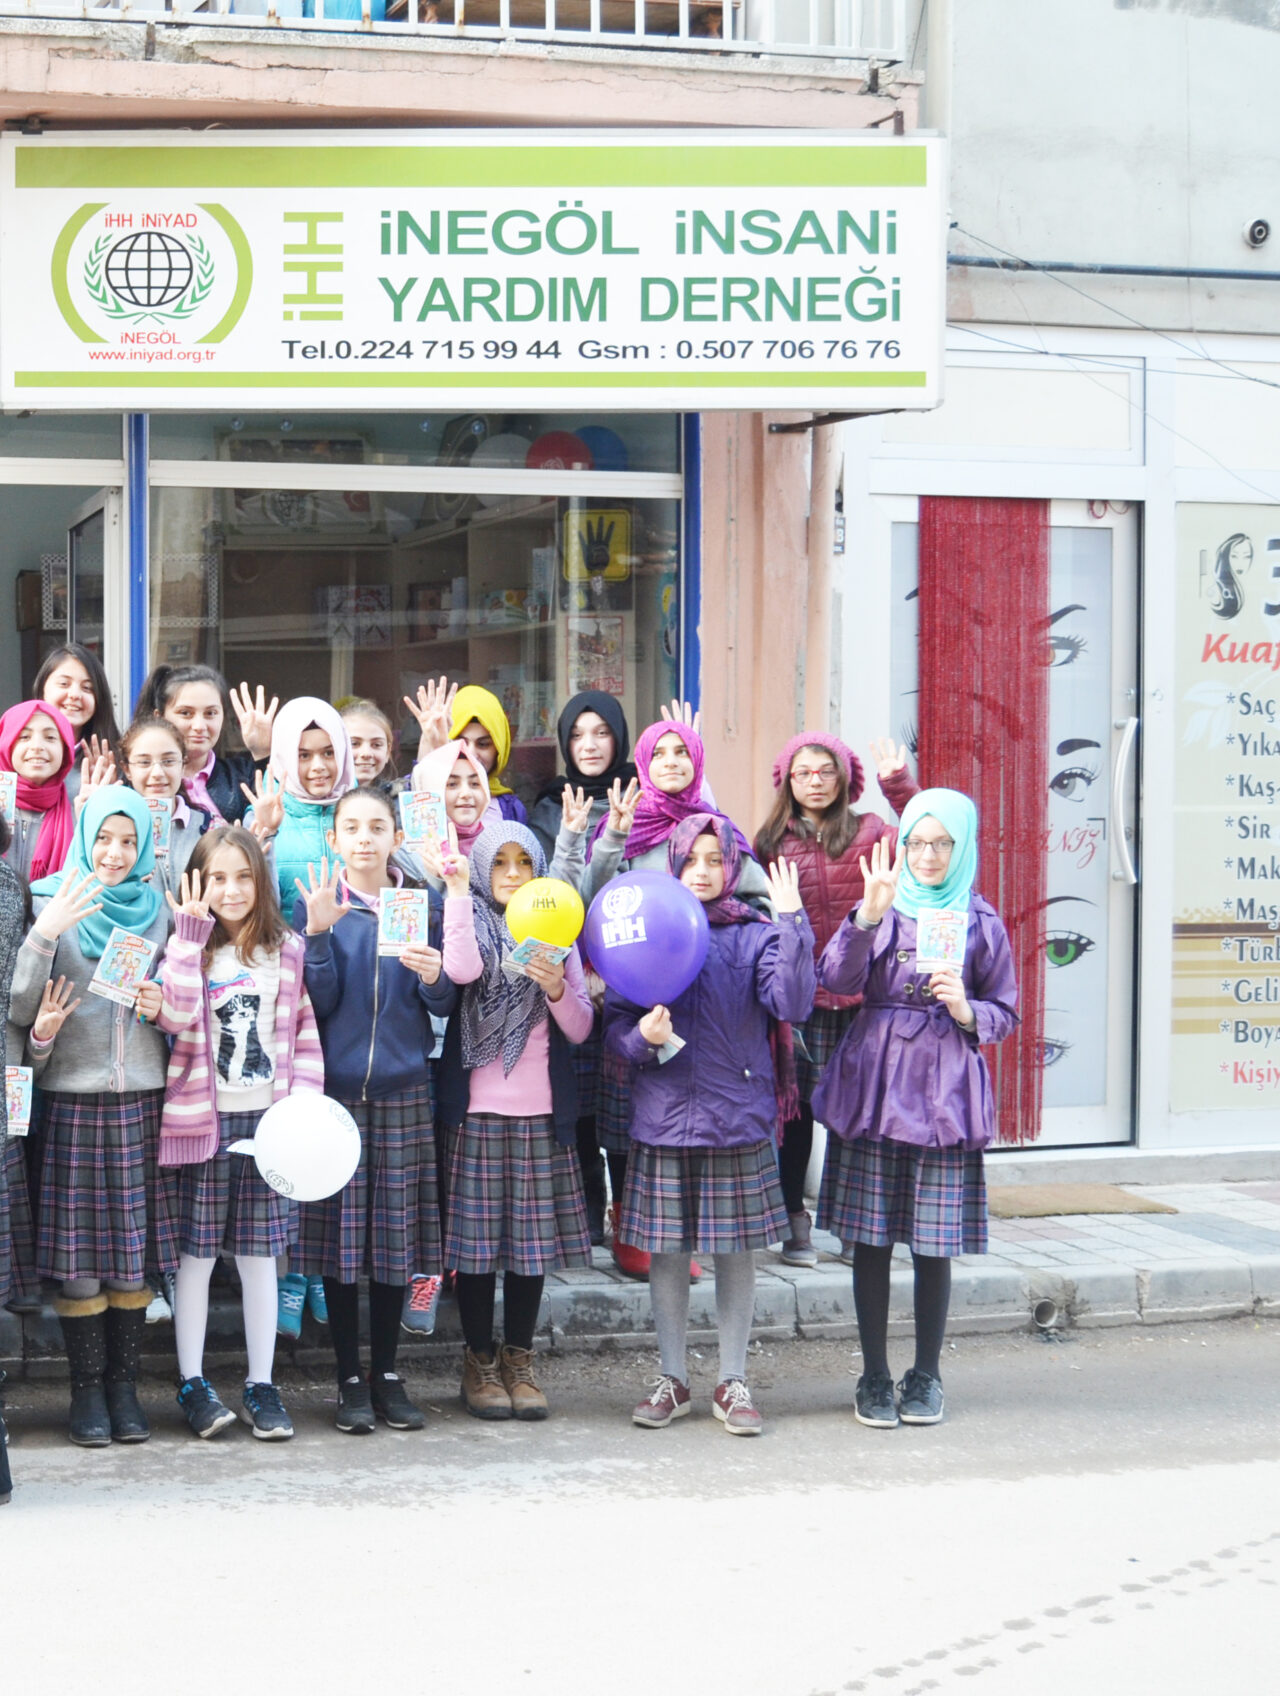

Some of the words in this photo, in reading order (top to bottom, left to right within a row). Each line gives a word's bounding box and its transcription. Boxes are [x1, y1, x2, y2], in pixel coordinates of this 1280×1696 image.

[377, 276, 608, 322] YARDIM
[88, 349, 217, 364] www.iniyad.org.tr
[422, 340, 475, 359] 715
[482, 340, 518, 359] 99
[525, 340, 562, 359] 44
[577, 340, 650, 359] Gsm
[676, 340, 754, 359] 0.507
[762, 340, 815, 359] 706
[823, 340, 858, 359] 76
[866, 340, 901, 359] 76
